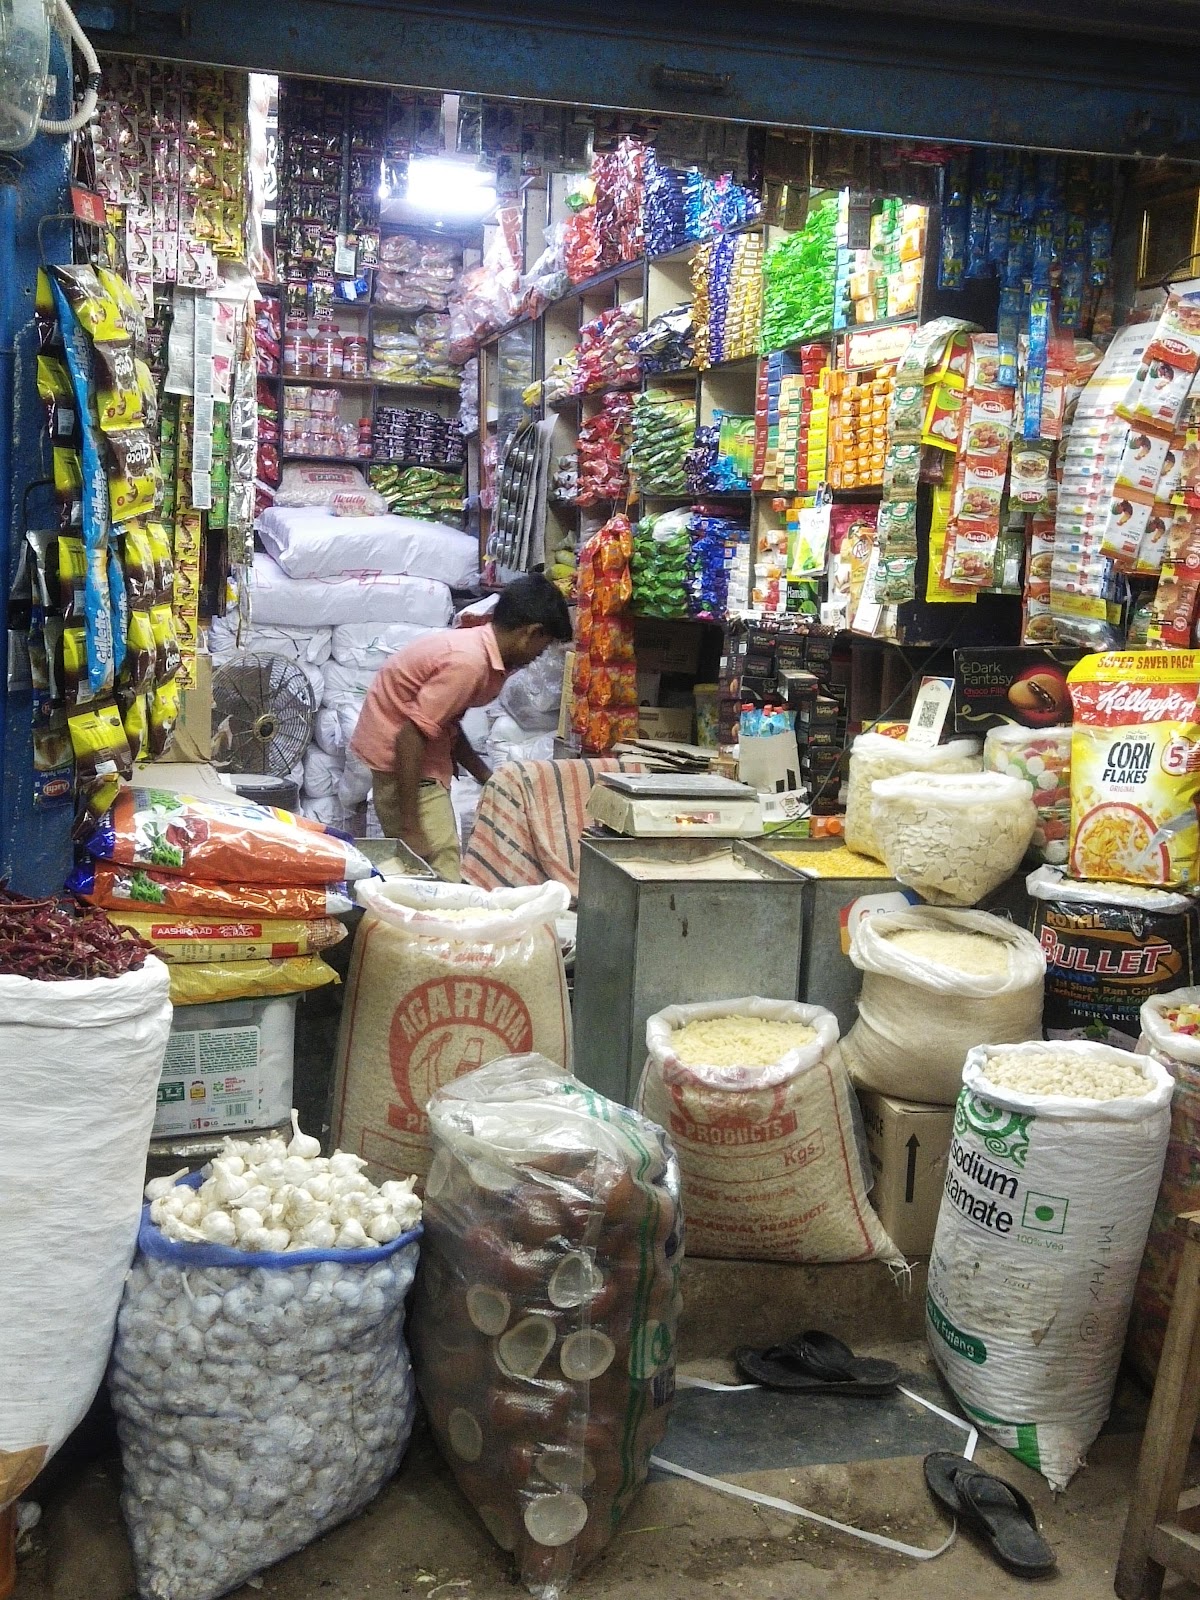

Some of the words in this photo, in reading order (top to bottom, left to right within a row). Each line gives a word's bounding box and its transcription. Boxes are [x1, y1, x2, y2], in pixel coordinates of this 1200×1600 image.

[1163, 340, 1190, 353] Aachi
[982, 402, 1003, 411] Aachi
[126, 442, 152, 464] Choco
[973, 469, 996, 478] Aachi
[1020, 491, 1042, 501] Aachi
[965, 532, 988, 542] Aachi
[1042, 532, 1055, 541] Aac
[96, 608, 108, 665] Gillette
[971, 662, 1001, 674] Dark
[1097, 656, 1135, 669] SUPER
[1136, 655, 1168, 670] SAVER
[1170, 655, 1196, 669] PACK
[963, 674, 1014, 687] Fantasy
[963, 687, 989, 695] Choco
[1096, 684, 1182, 721] Kellogg's
[1107, 741, 1156, 770] CORN
[1168, 745, 1184, 768] 5
[1102, 768, 1149, 784] FLAKES
[46, 783, 68, 795] Aachi
[1109, 784, 1135, 793] ORIGINAL
[1046, 911, 1105, 929] ROYAL
[1040, 925, 1172, 974] BULLET
[1070, 981, 1099, 995] Shree
[1102, 985, 1128, 996] Ram
[1131, 986, 1159, 997] Gold
[399, 981, 529, 1049] AGARWAL
[1071, 1008, 1110, 1021] JEERA
[1117, 1004, 1141, 1014] RIC
[684, 1119, 783, 1146] PRODUCTS
[783, 1141, 820, 1167] Kgs.
[951, 1138, 1019, 1199] sodium
[1016, 1233, 1043, 1248] 100%
[1045, 1239, 1064, 1252] Veg
